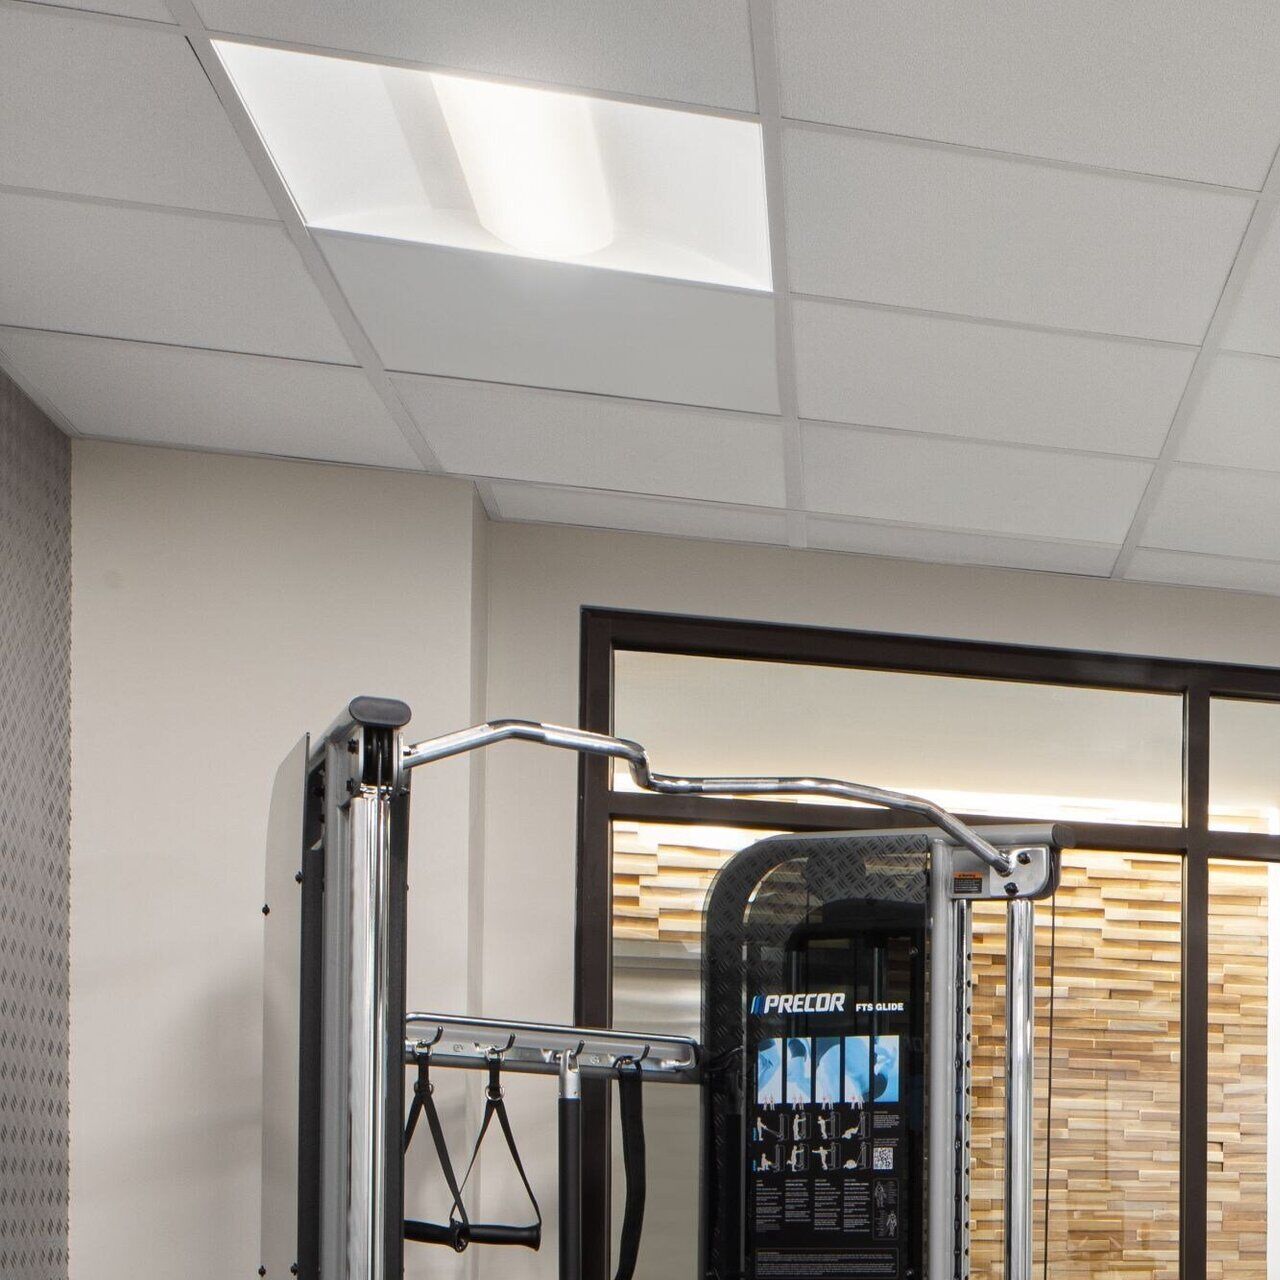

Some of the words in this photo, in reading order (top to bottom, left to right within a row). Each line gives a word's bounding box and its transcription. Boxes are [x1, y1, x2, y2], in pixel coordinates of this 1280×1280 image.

[763, 993, 846, 1014] PRECOR
[855, 1003, 873, 1012] FTS
[875, 1003, 904, 1011] GLIDE
